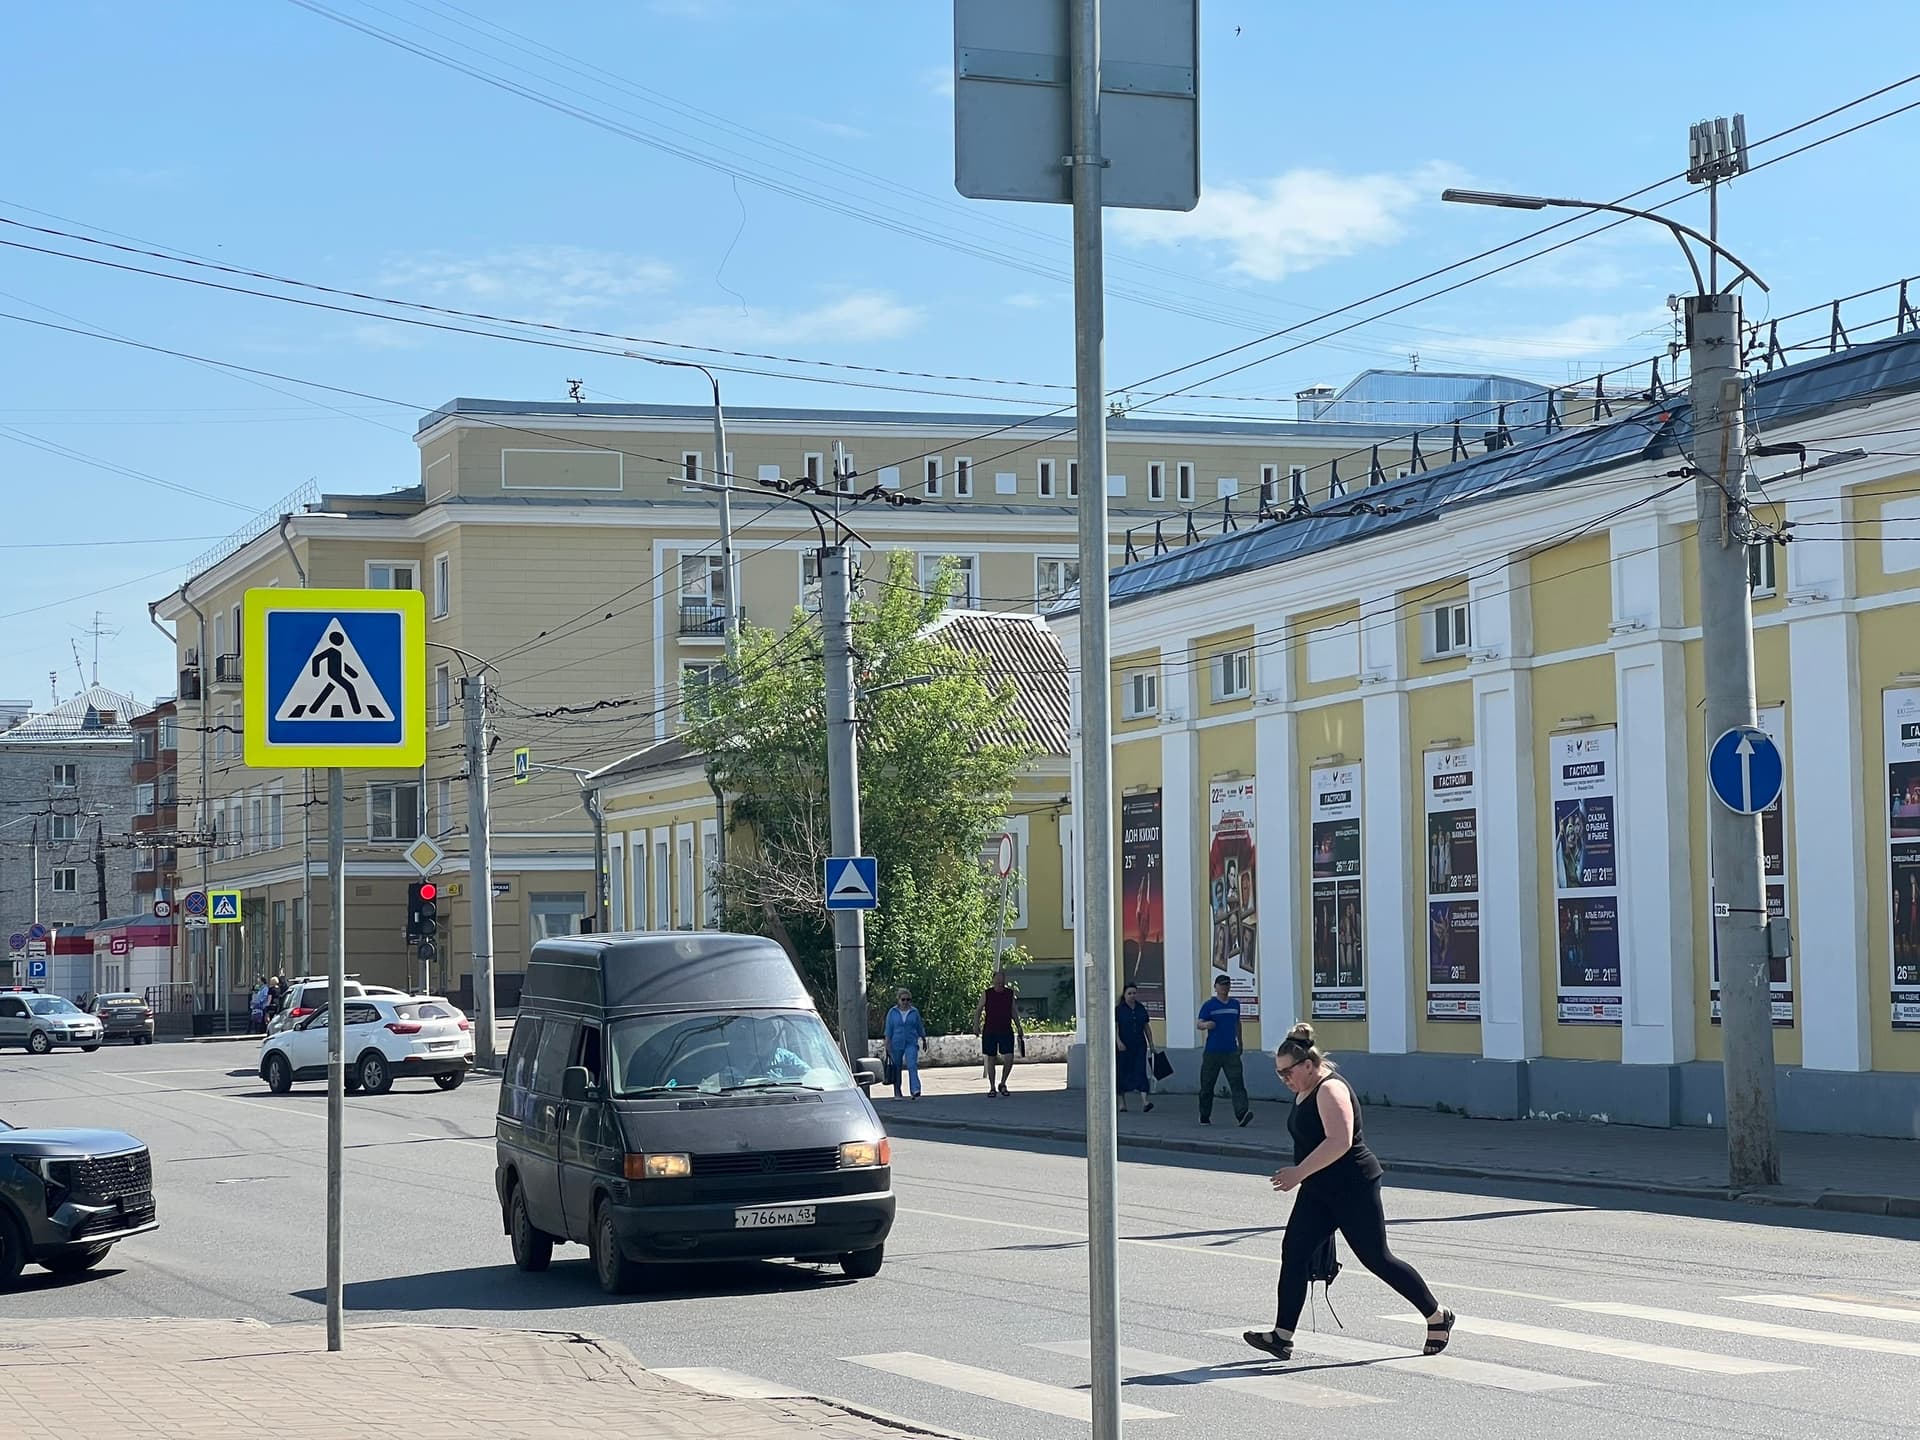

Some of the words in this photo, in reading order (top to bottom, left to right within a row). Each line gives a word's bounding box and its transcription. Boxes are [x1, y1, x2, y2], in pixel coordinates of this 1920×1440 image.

[1569, 763, 1599, 778] ГАСТРОЛИ
[1439, 773, 1467, 788] ГАСТРОЛИ
[1212, 788, 1219, 803] 22
[1324, 792, 1347, 804] ГАСТРОЛИ
[1587, 813, 1606, 822] СКАЗКА
[1456, 821, 1472, 830] СКАЗКА
[1590, 822, 1609, 831] РЫБАКЕ
[1125, 828, 1138, 843] ДОН
[1139, 827, 1159, 842] КИХОТ
[1591, 831, 1608, 840] РЫБКЕ
[1147, 854, 1154, 867] 24
[1464, 875, 1471, 887] 29
[1583, 869, 1592, 882] 20
[1599, 868, 1607, 881] 21
[1450, 875, 1458, 888] 28
[1585, 911, 1597, 919] АЛЫЕ
[1598, 911, 1615, 919] ПАРУСА
[1451, 966, 1459, 979] 28
[1585, 968, 1593, 981] 20
[1603, 968, 1611, 981] 21
[1897, 966, 1908, 980] 26
[798, 1208, 810, 1220] 43
